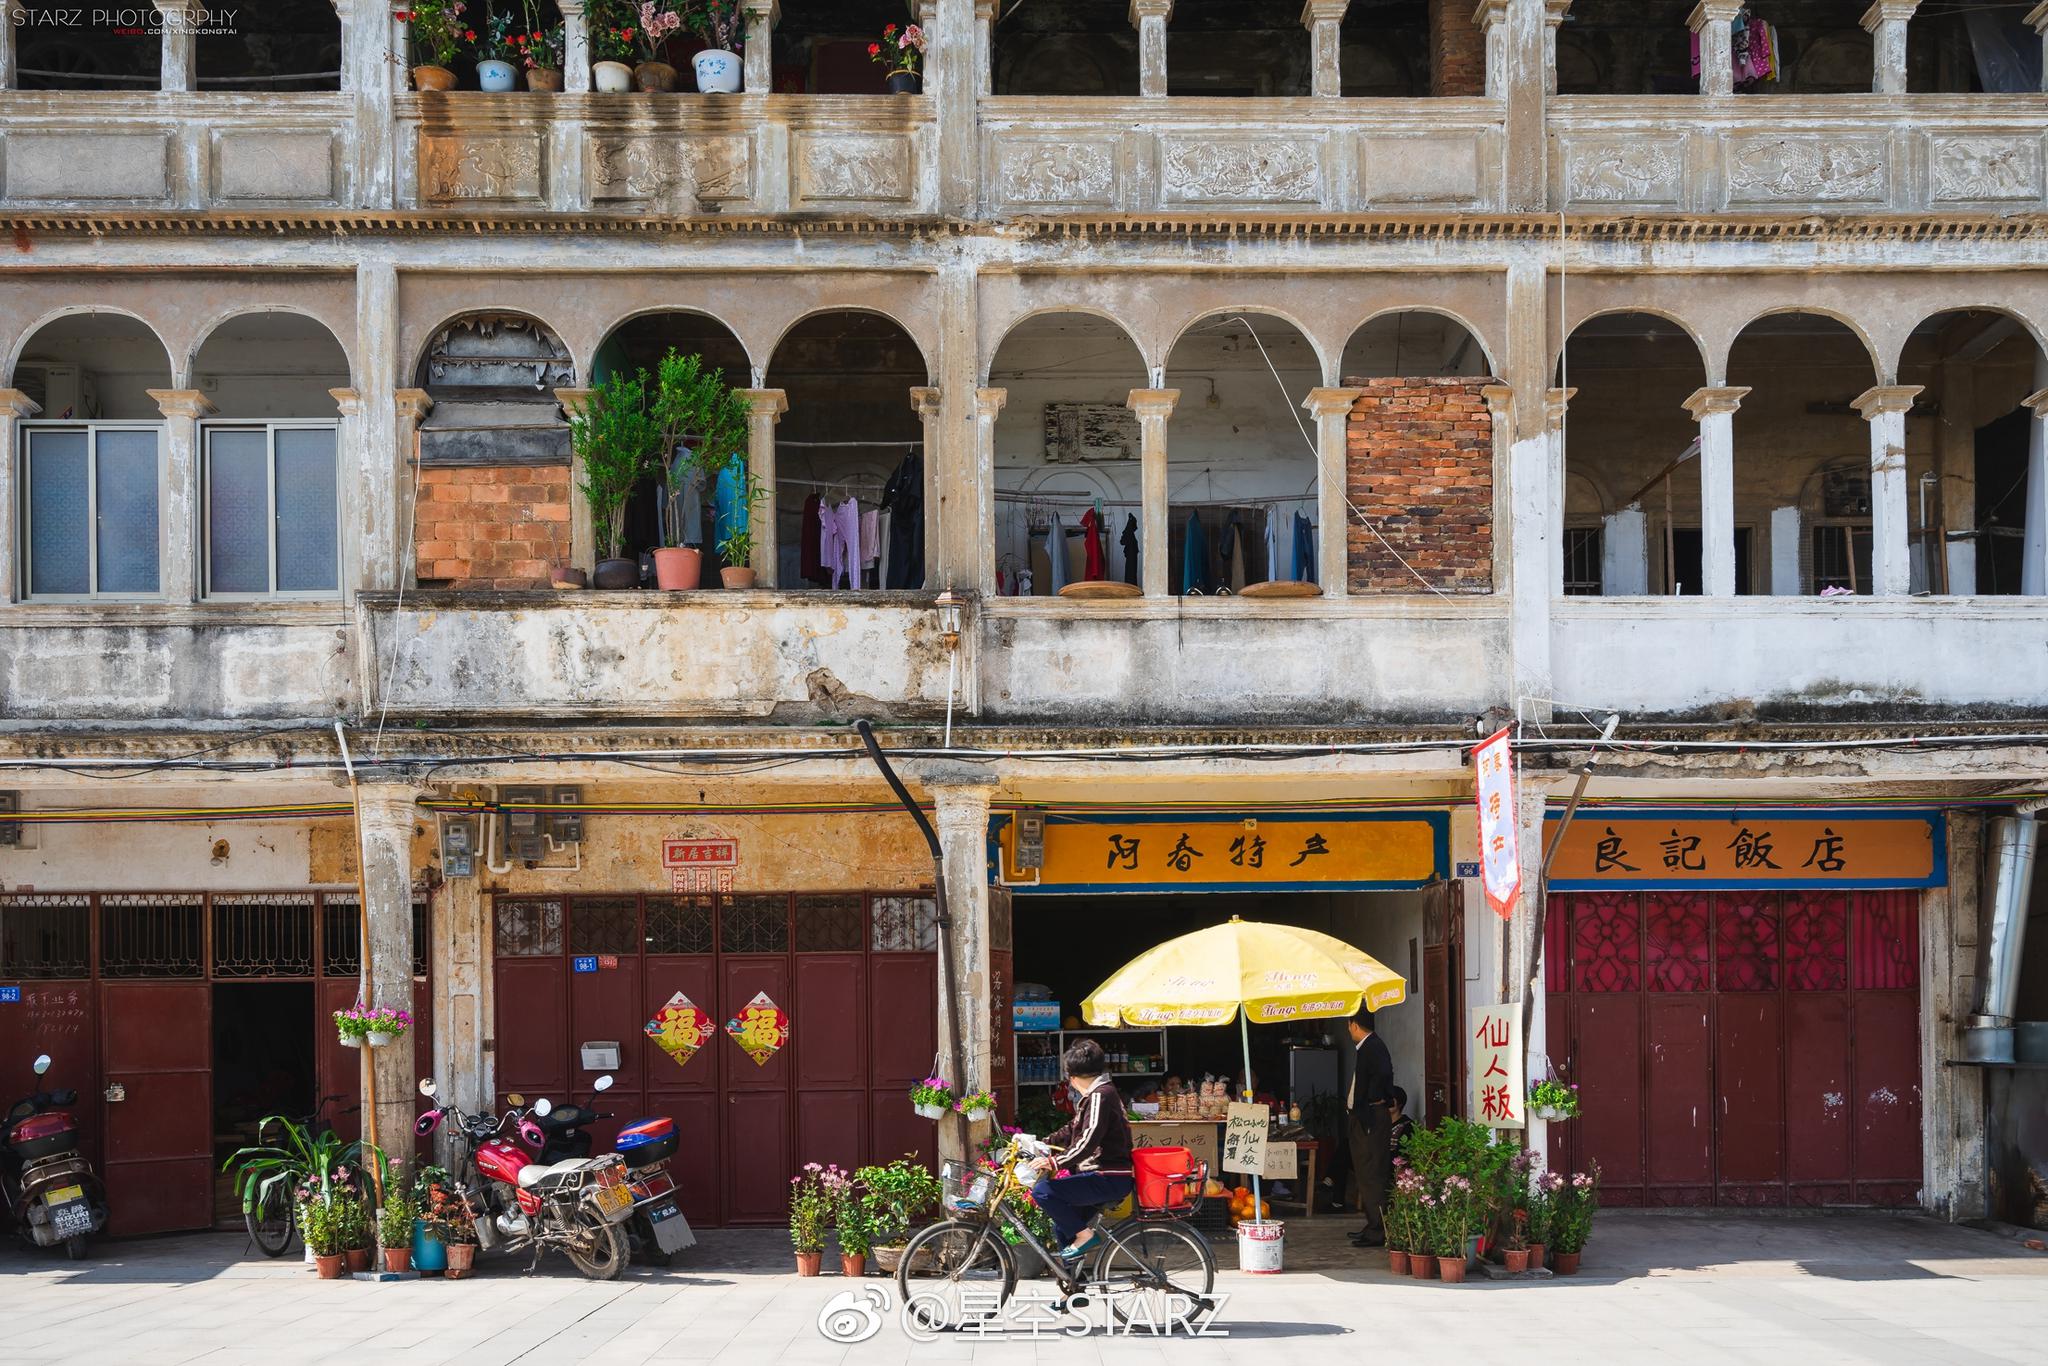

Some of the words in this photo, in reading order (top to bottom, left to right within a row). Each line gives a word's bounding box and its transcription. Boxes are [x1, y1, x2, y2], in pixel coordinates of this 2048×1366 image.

[672, 847, 728, 860] 新居吉祥
[1107, 833, 1330, 872] 阿春特产
[1595, 826, 1847, 873] 良記飯店
[660, 1008, 701, 1045] 福
[741, 1008, 781, 1045] 福
[1134, 1133, 1206, 1147] 松口小吃
[1228, 1115, 1267, 1129] 松口小吃
